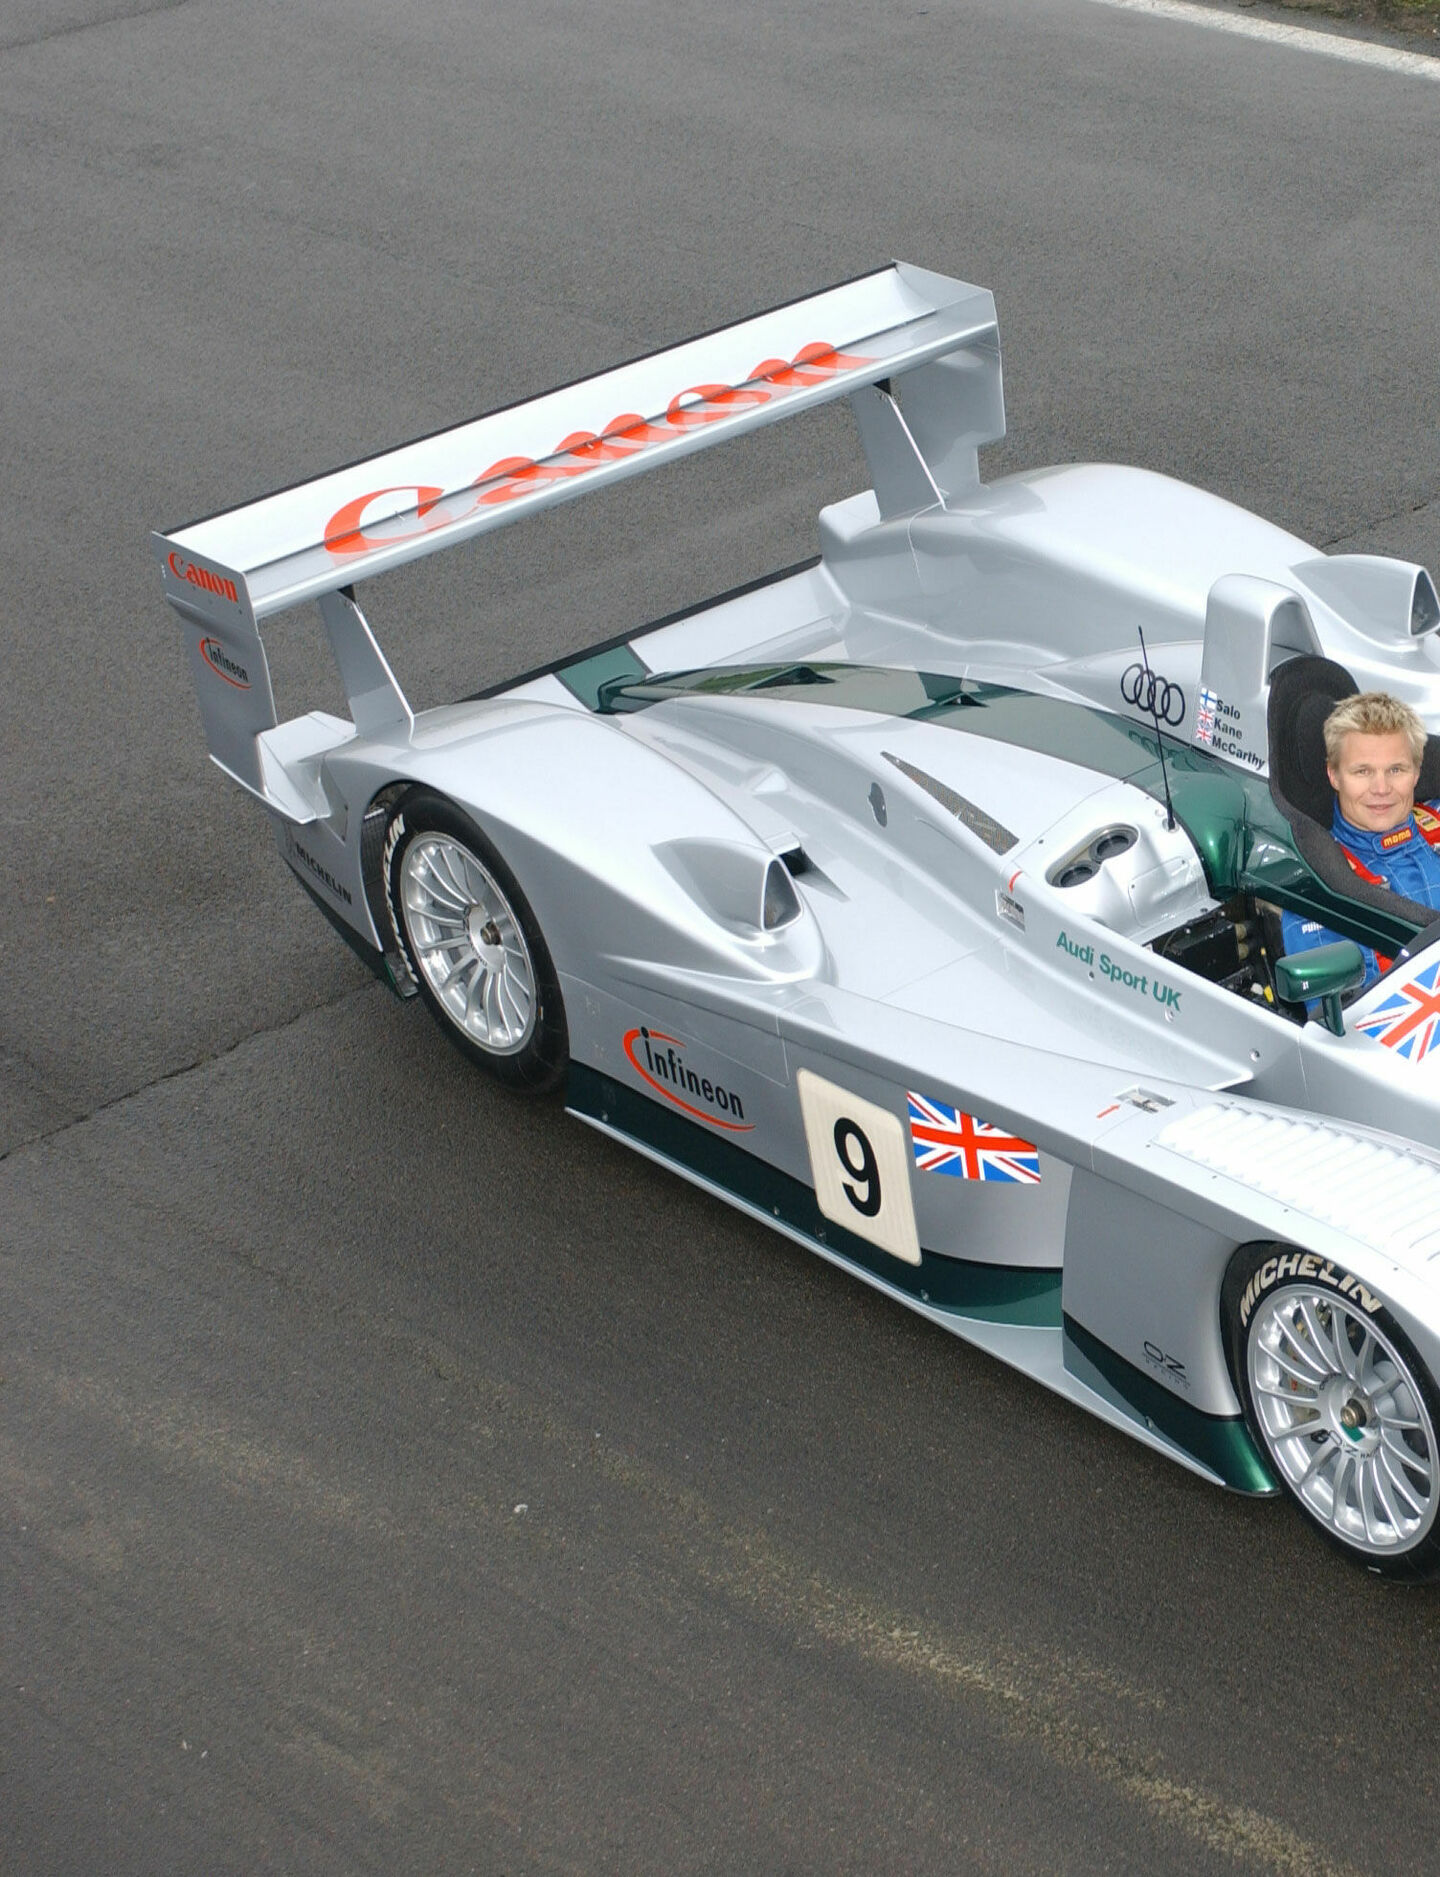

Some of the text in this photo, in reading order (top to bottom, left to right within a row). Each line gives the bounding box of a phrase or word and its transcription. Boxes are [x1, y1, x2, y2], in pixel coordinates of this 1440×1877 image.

[323, 341, 882, 560] Canon
[168, 551, 239, 603] Canon
[1214, 717, 1243, 740] Kane
[1216, 699, 1241, 720] Salo
[1212, 735, 1266, 771] McCarthy
[295, 841, 352, 906] MICHELIN
[1056, 931, 1182, 1012] Audi Sport UK
[833, 1116, 882, 1218] 9
[1239, 1252, 1385, 1328] MICHELIN
